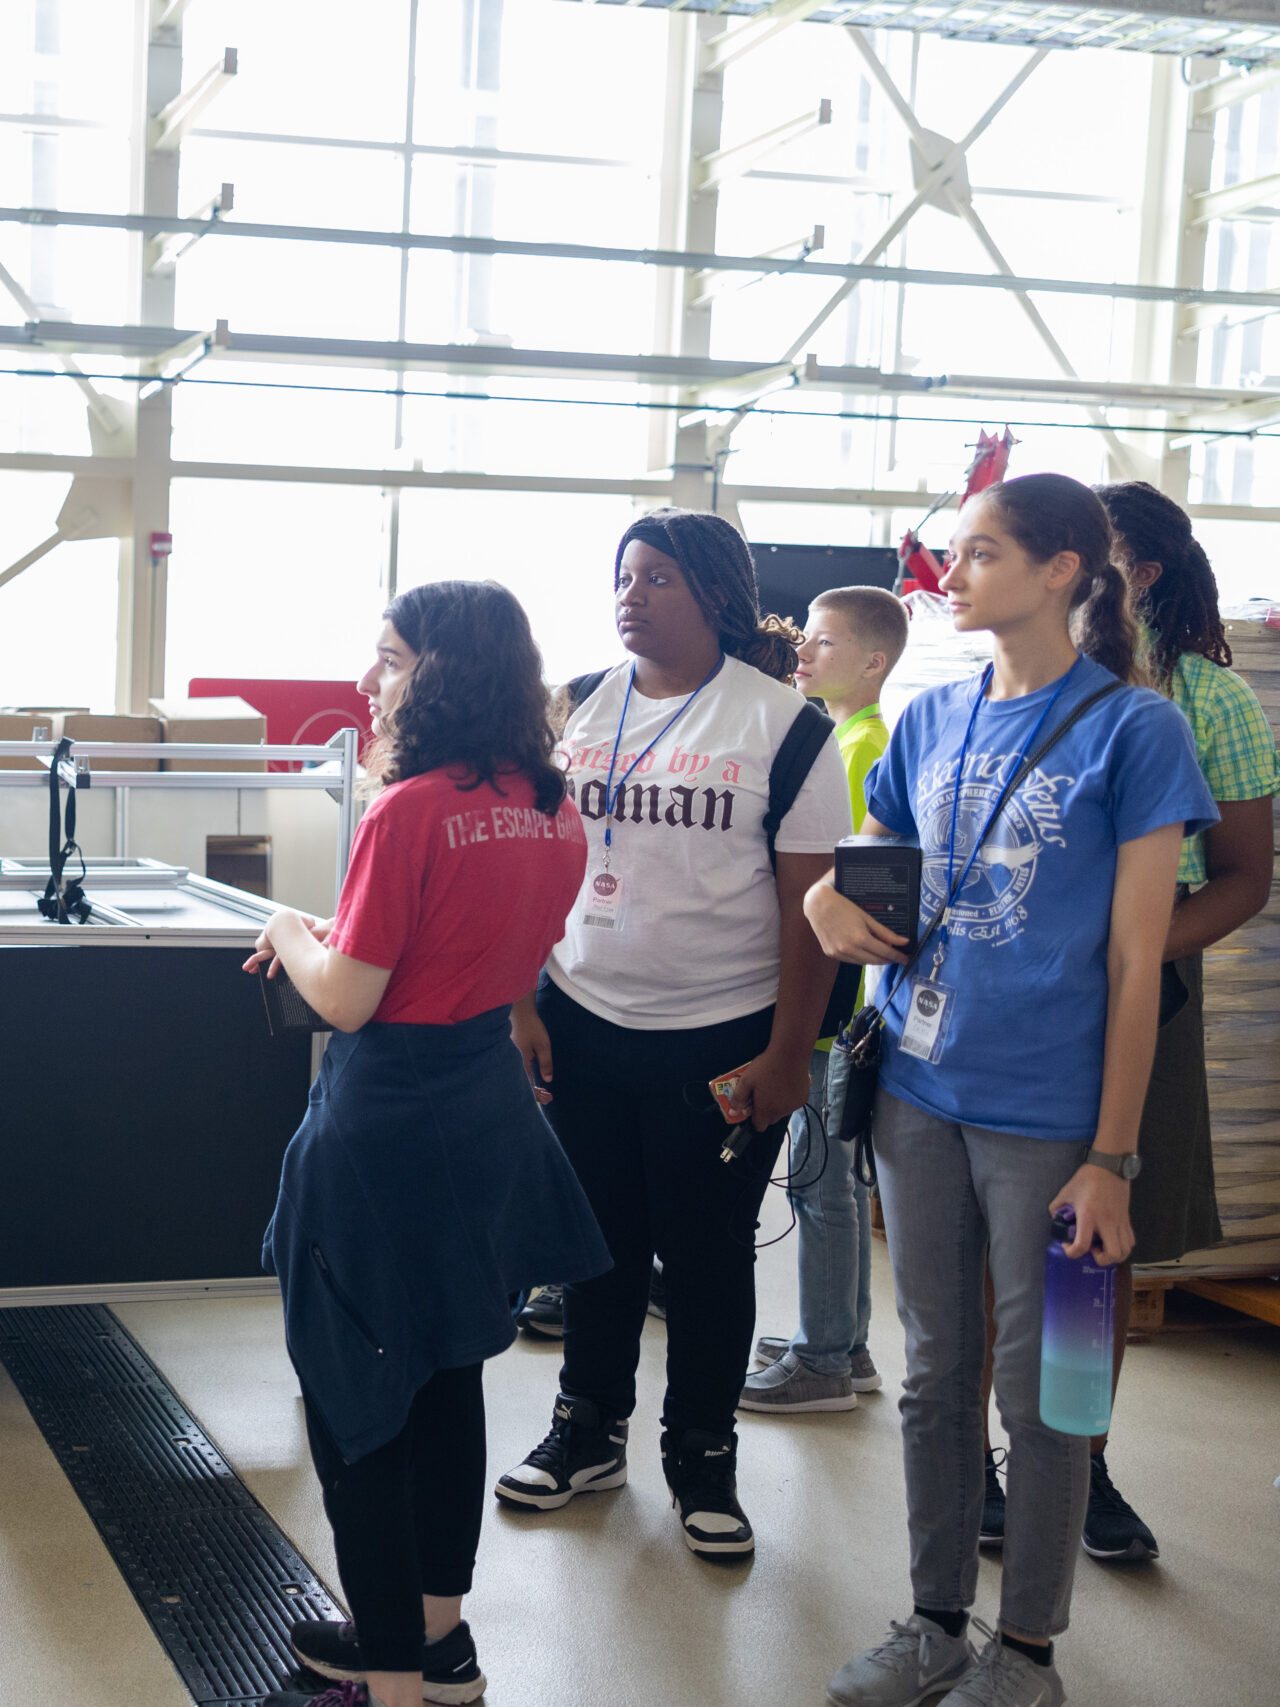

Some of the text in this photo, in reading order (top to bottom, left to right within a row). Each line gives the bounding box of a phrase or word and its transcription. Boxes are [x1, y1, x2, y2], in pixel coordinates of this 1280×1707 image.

[668, 746, 710, 782] by
[722, 760, 742, 784] a
[566, 777, 735, 832] oman
[442, 811, 489, 849] THE
[491, 806, 554, 839] ESCAPE
[595, 880, 616, 889] NASA
[918, 996, 938, 1010] NASA
